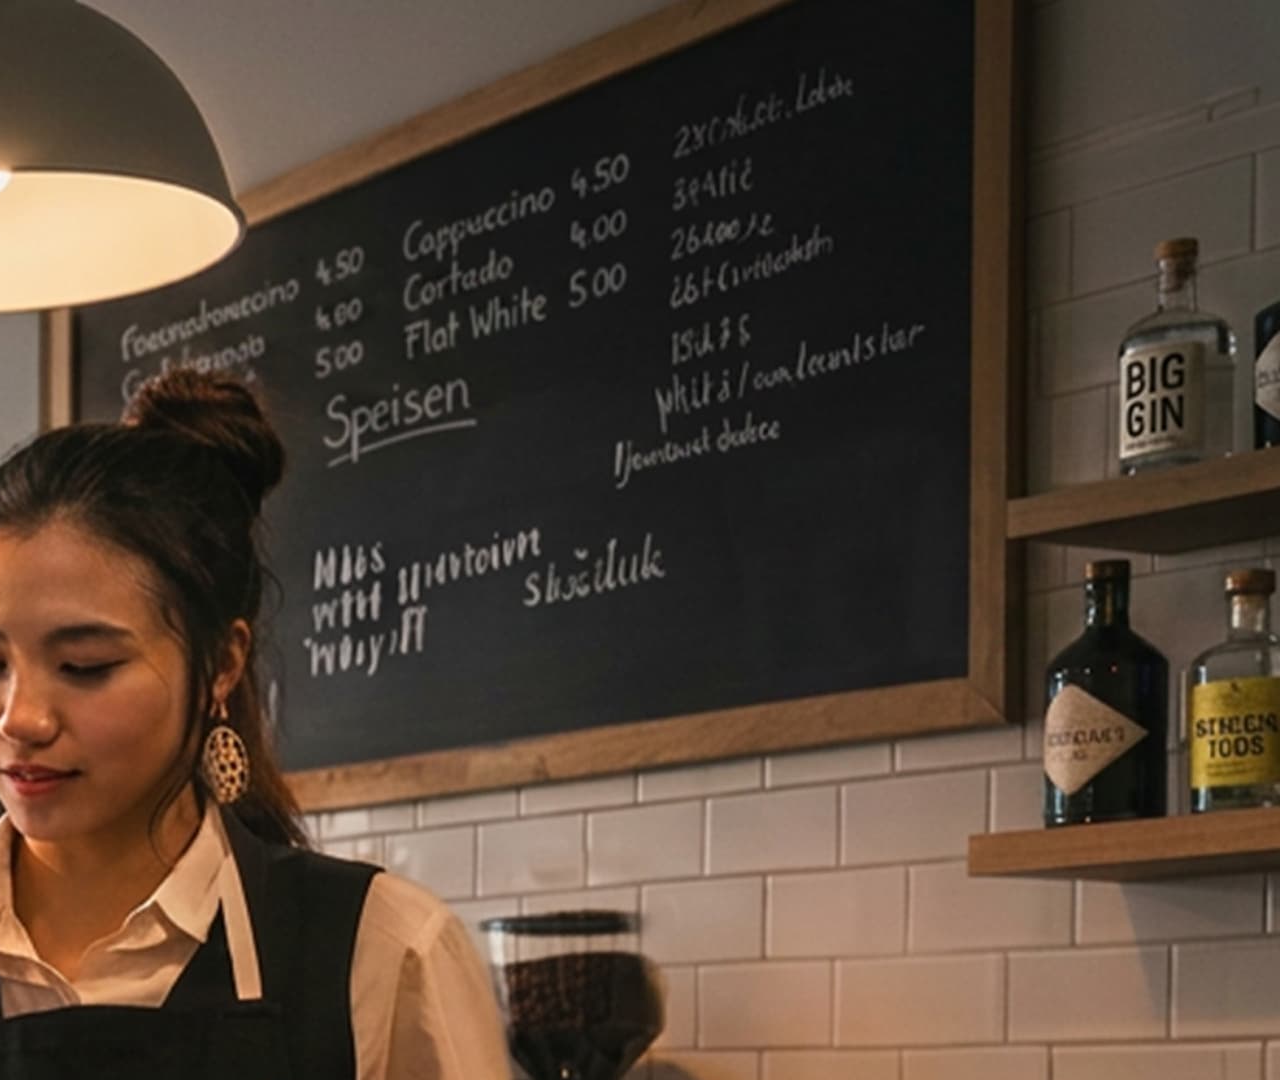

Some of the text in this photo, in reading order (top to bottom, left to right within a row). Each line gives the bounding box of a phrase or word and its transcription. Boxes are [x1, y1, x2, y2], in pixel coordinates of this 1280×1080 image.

[403, 186, 556, 261] Cappuccino
[570, 153, 630, 198] 4.50
[403, 249, 513, 311] Cortado
[404, 310, 460, 360] Flat
[469, 286, 547, 339] White
[1127, 352, 1185, 400] BIG
[322, 377, 472, 463] Speisen
[1126, 396, 1184, 438] GIN
